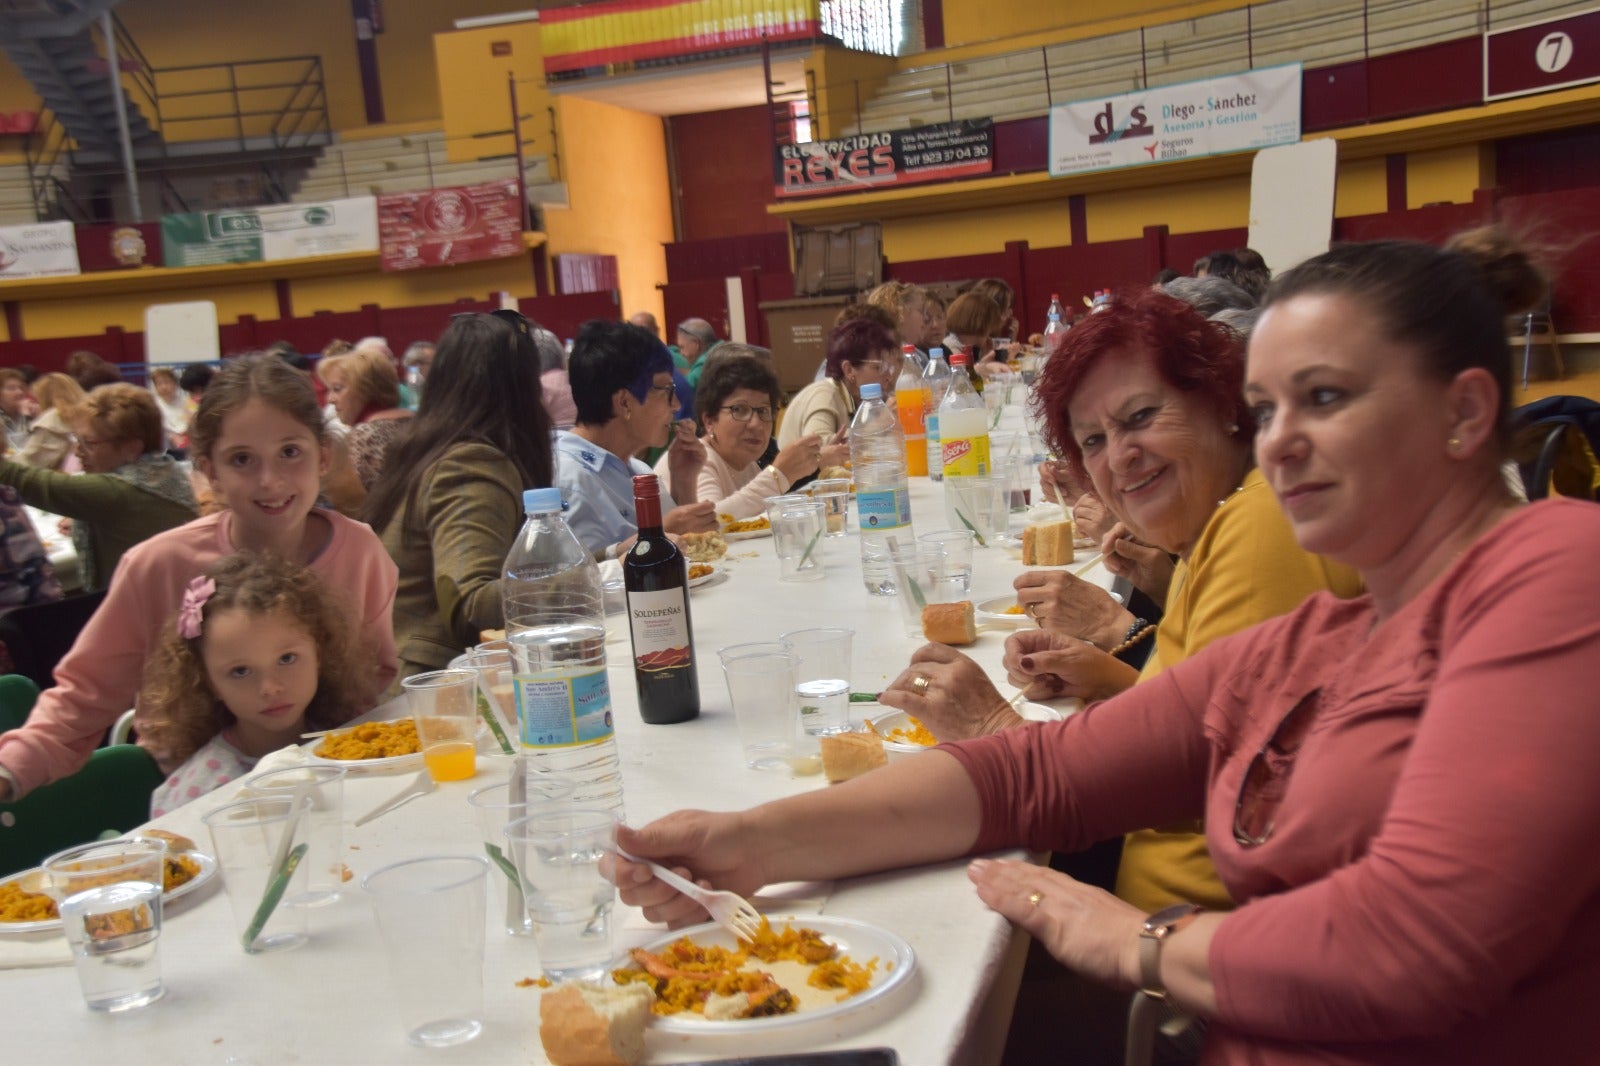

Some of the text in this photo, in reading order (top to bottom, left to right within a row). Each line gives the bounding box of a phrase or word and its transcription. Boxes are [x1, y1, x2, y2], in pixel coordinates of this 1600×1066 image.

[1545, 36, 1564, 69] 7
[1162, 104, 1196, 120] Diego
[1161, 138, 1194, 150] Seguros
[922, 151, 942, 164] 923
[943, 148, 955, 161] 37
[956, 147, 971, 160] 04
[973, 144, 988, 157] 30
[1161, 149, 1188, 160] Bilbao
[784, 145, 895, 187] REYES
